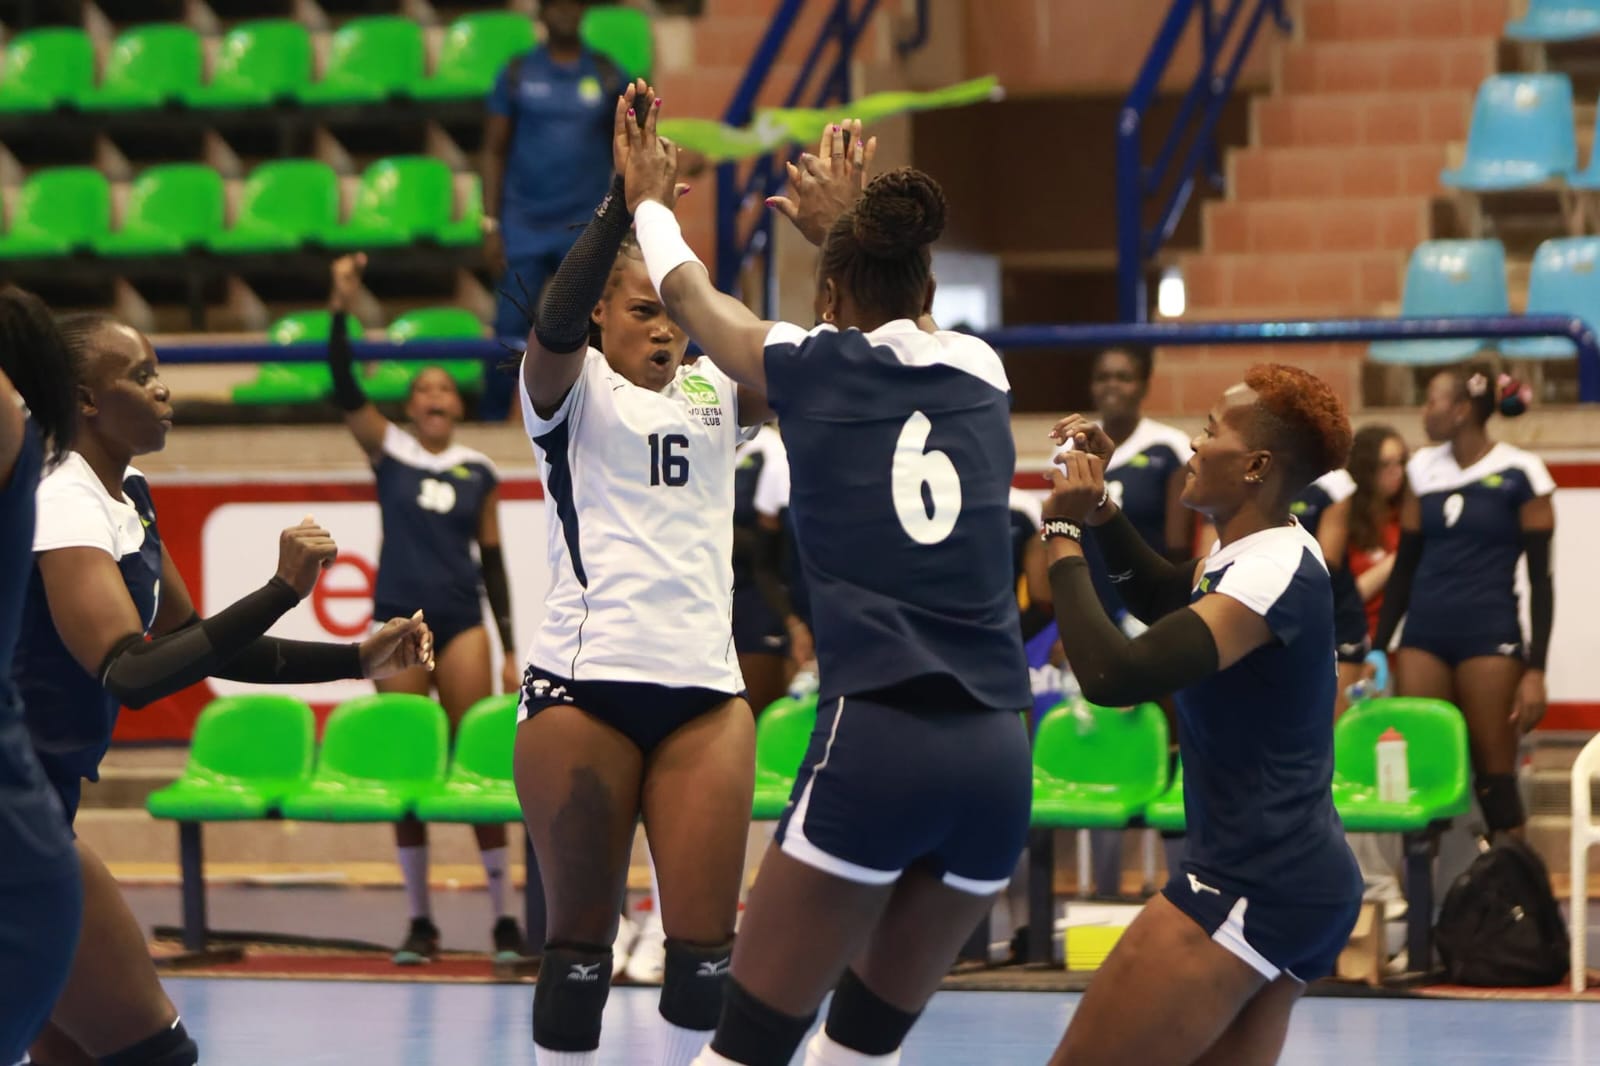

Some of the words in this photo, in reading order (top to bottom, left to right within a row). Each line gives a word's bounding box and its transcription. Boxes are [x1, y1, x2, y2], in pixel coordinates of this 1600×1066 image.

[648, 433, 689, 487] 16
[892, 410, 962, 545] 6
[1443, 493, 1464, 528] 9
[312, 552, 378, 638] e
